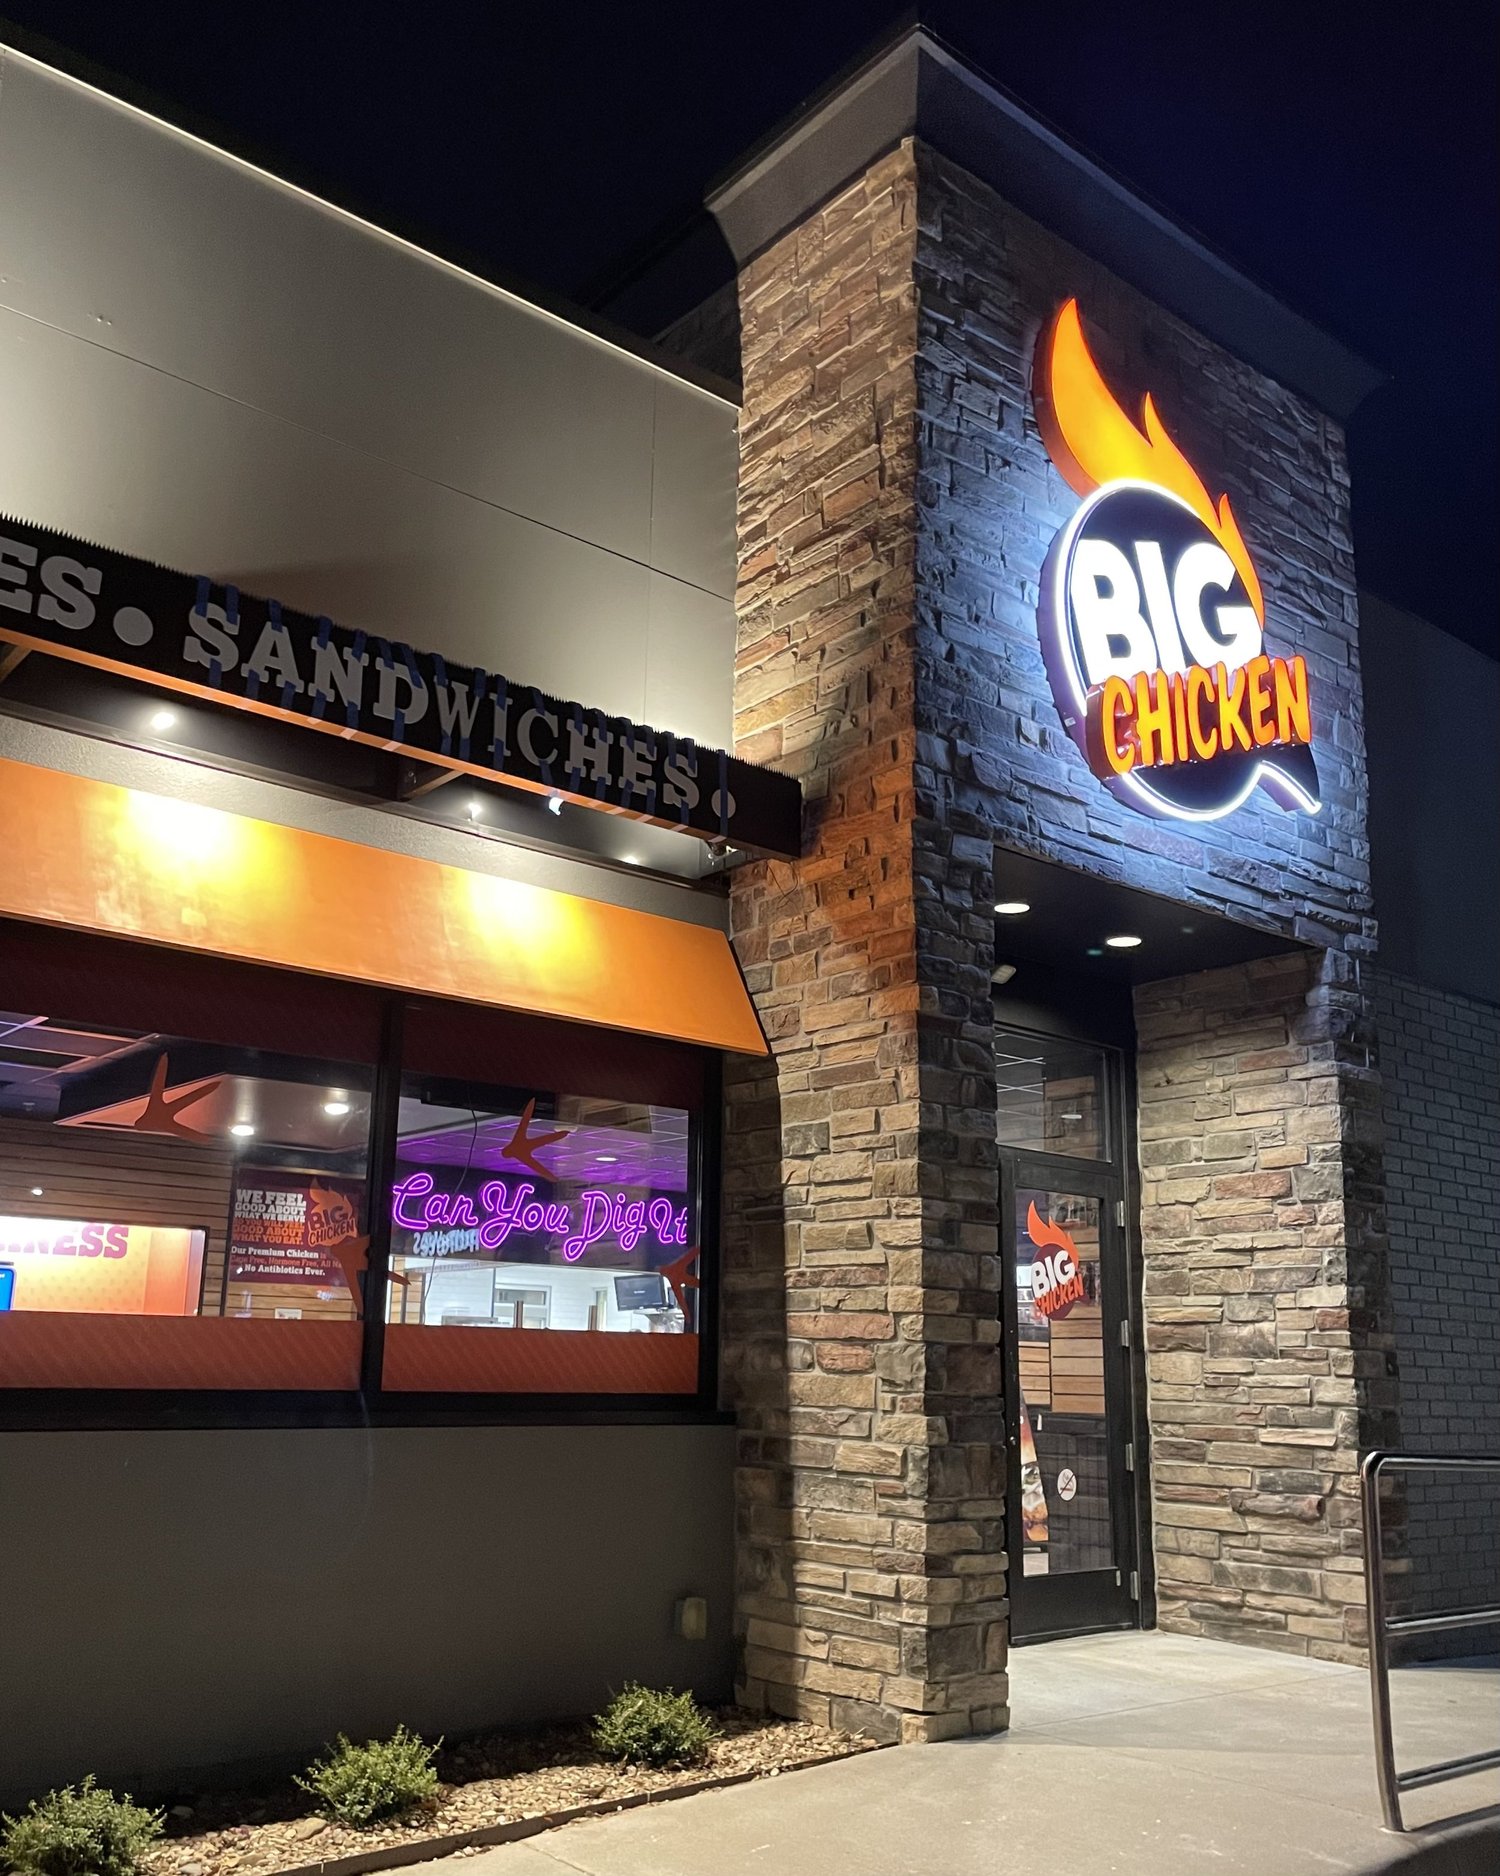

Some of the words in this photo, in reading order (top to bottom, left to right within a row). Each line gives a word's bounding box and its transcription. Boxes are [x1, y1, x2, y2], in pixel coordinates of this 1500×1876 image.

[1070, 538, 1264, 685] BIG
[1102, 655, 1312, 775] CHICKEN
[236, 1188, 263, 1204] WE
[265, 1191, 307, 1207] FEEL
[234, 1211, 261, 1219] WHAT
[262, 1212, 276, 1220] WE
[235, 1202, 266, 1212] GOOD
[267, 1204, 306, 1215] ABOUT
[393, 1173, 478, 1230] Can
[480, 1181, 569, 1249] You
[564, 1190, 647, 1262] Dig
[649, 1198, 688, 1244] It
[309, 1206, 349, 1231] BIG
[262, 1234, 282, 1244] YOU
[266, 1226, 305, 1237] ABOUT
[309, 1218, 355, 1245] CHICKEN
[231, 1246, 247, 1254] Our
[247, 1247, 285, 1257] Premium
[286, 1249, 319, 1259] Chicken
[244, 1264, 256, 1272] No
[258, 1264, 304, 1275] Antibiotics
[304, 1267, 326, 1276] Ever.
[1031, 1250, 1076, 1298] BIG
